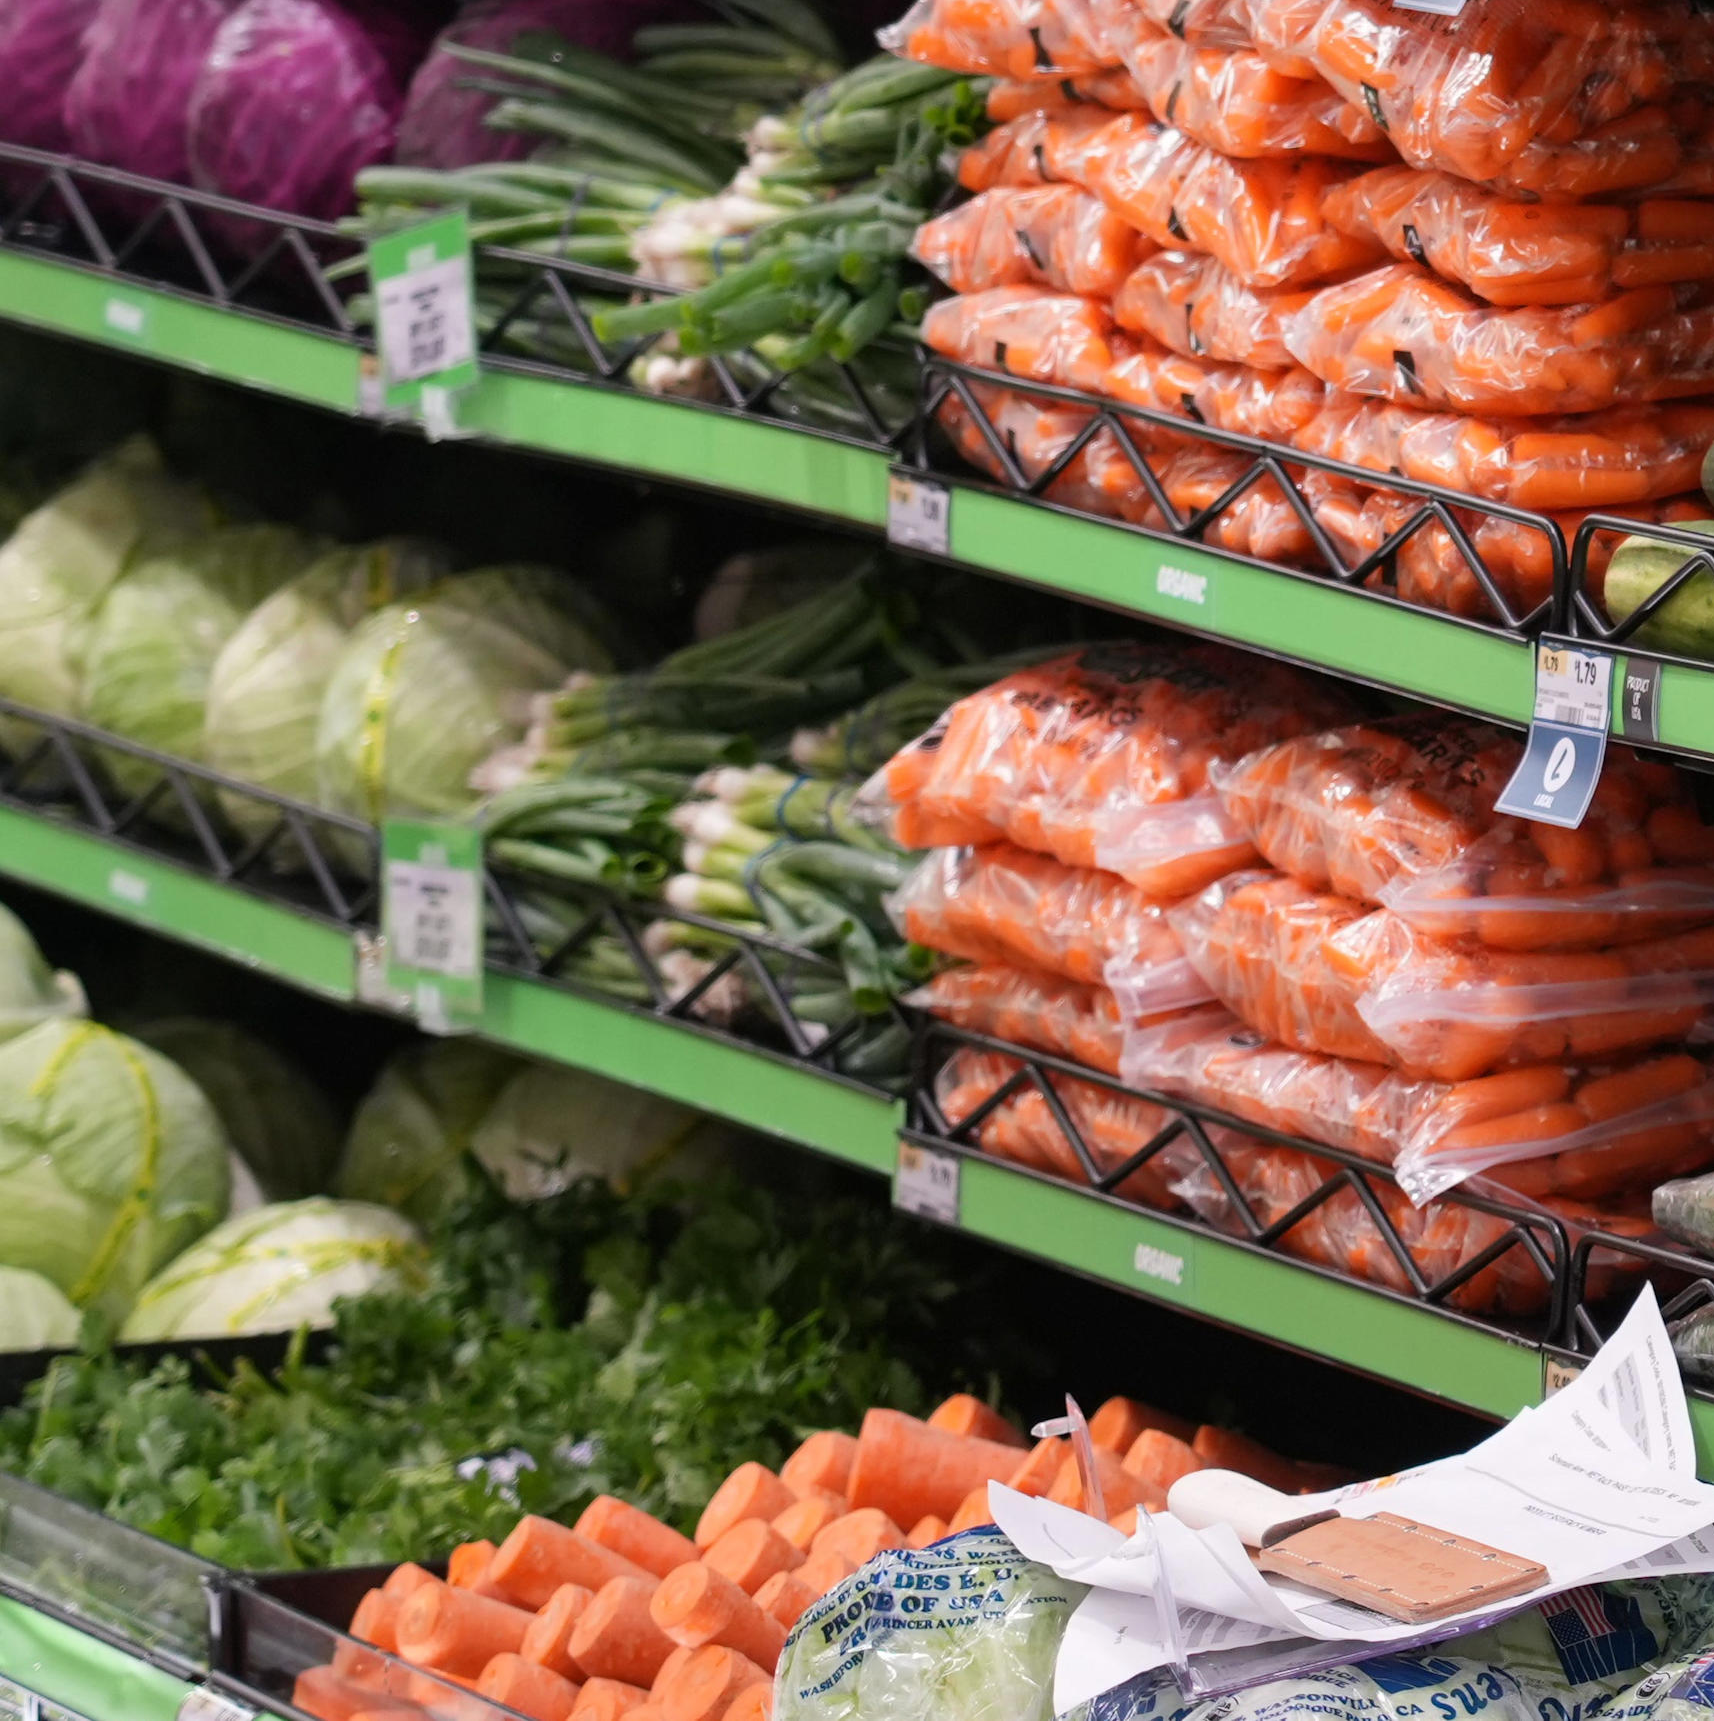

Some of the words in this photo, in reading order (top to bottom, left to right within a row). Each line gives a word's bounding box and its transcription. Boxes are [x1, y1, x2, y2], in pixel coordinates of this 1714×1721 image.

[893, 1572, 951, 1591] DES
[901, 1595, 939, 1614] OF
[881, 1617, 933, 1630] RINCER
[799, 1674, 834, 1700] WASH
[1395, 1703, 1425, 1717] CA
